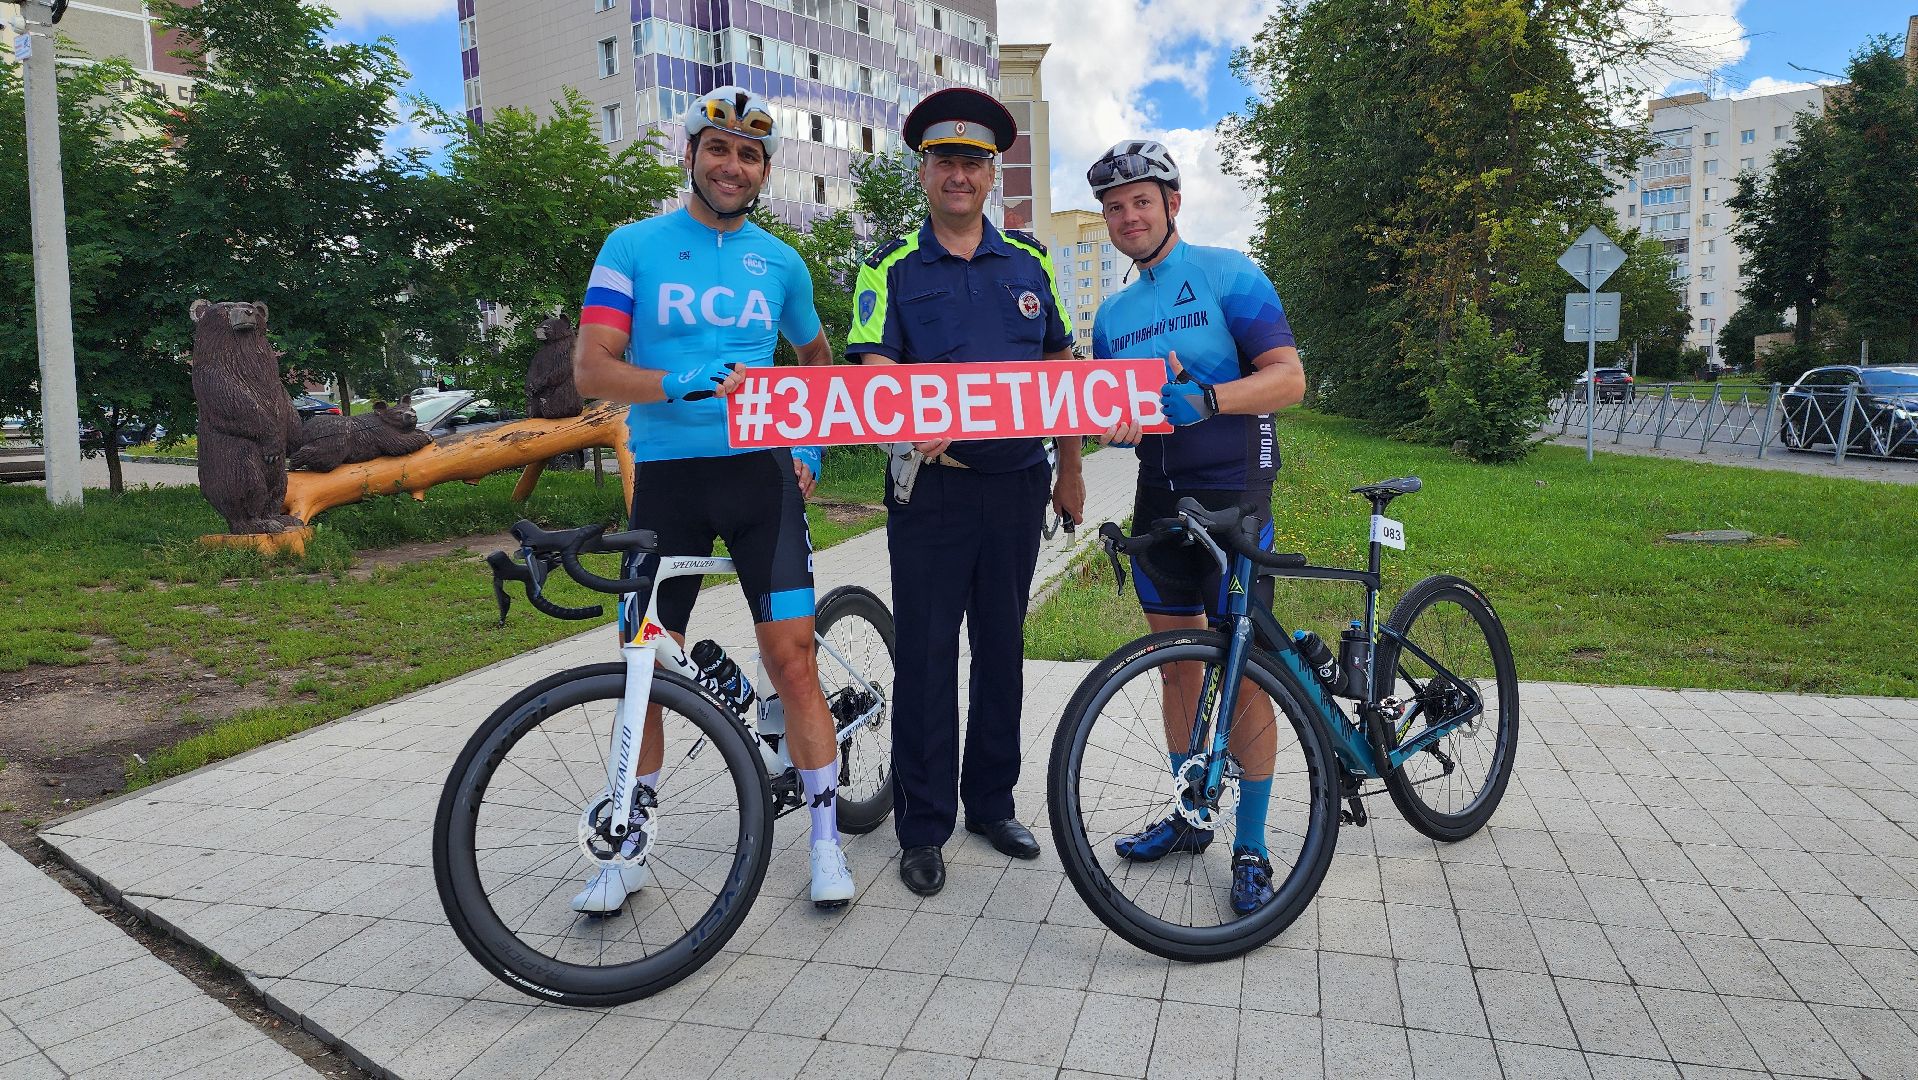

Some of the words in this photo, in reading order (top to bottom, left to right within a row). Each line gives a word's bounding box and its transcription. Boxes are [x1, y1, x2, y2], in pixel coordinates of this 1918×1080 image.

[658, 283, 773, 330] RCA
[1168, 310, 1209, 332] УГОЛОК
[735, 369, 1165, 441] #ЗАСВЕТИСЬ
[1259, 423, 1273, 469] УГОЛОК
[1383, 526, 1401, 541] 083
[671, 560, 715, 569] SPECIALIZED
[703, 659, 722, 674] BORA
[614, 725, 632, 811] SPECIALIZED
[495, 939, 568, 980] RAPIDE
